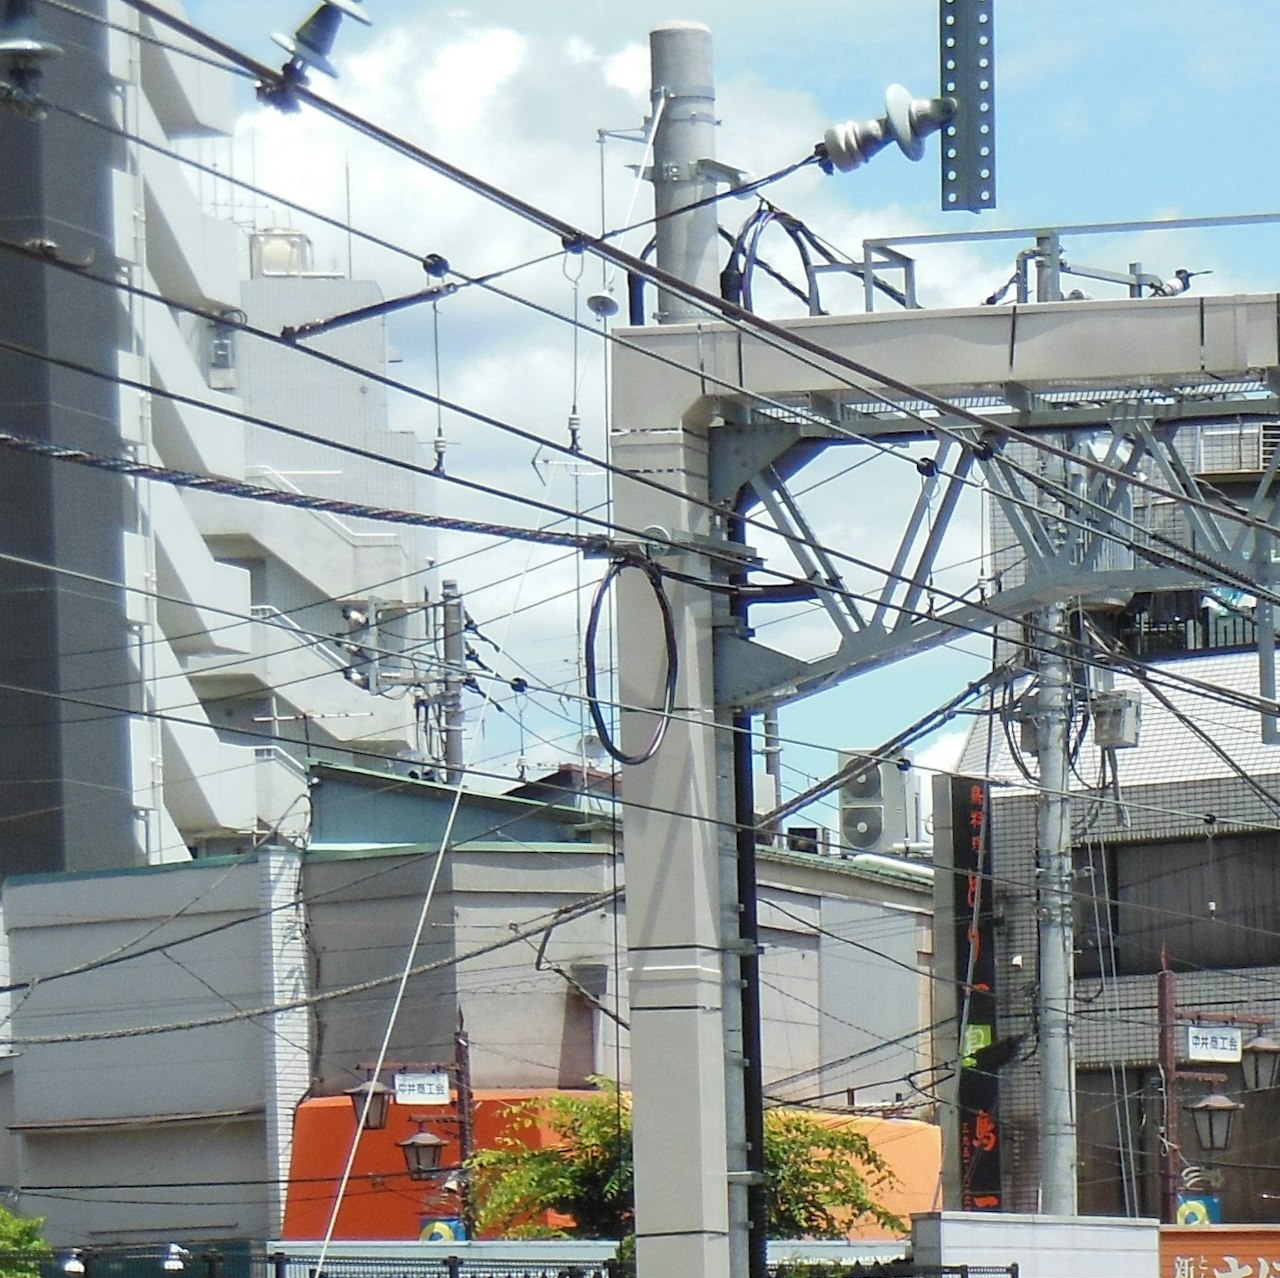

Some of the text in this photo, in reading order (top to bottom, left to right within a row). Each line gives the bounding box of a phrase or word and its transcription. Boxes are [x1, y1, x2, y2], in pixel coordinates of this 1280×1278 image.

[1192, 1035, 1237, 1051] 中井商工会
[398, 1083, 445, 1095] 中井商工会
